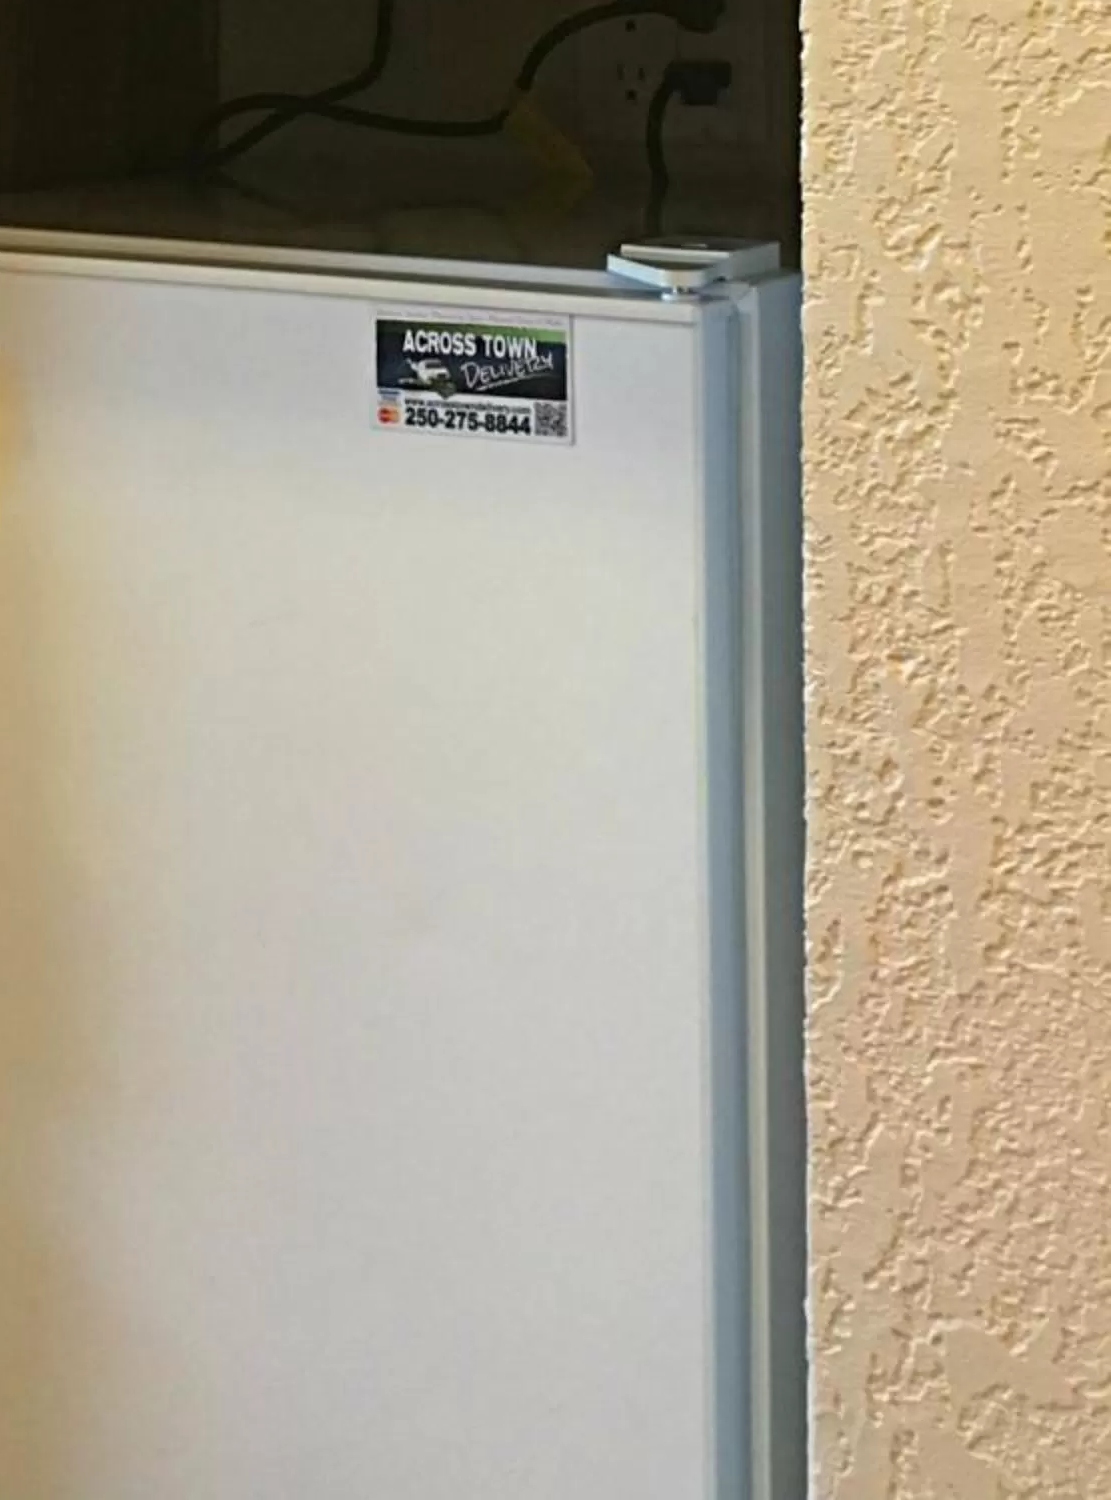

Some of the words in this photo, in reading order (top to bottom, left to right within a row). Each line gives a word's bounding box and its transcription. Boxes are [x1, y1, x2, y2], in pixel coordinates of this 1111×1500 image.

[403, 329, 477, 356] ACROSS
[481, 335, 537, 359] TOWN
[405, 408, 531, 434] 250-275-8844
